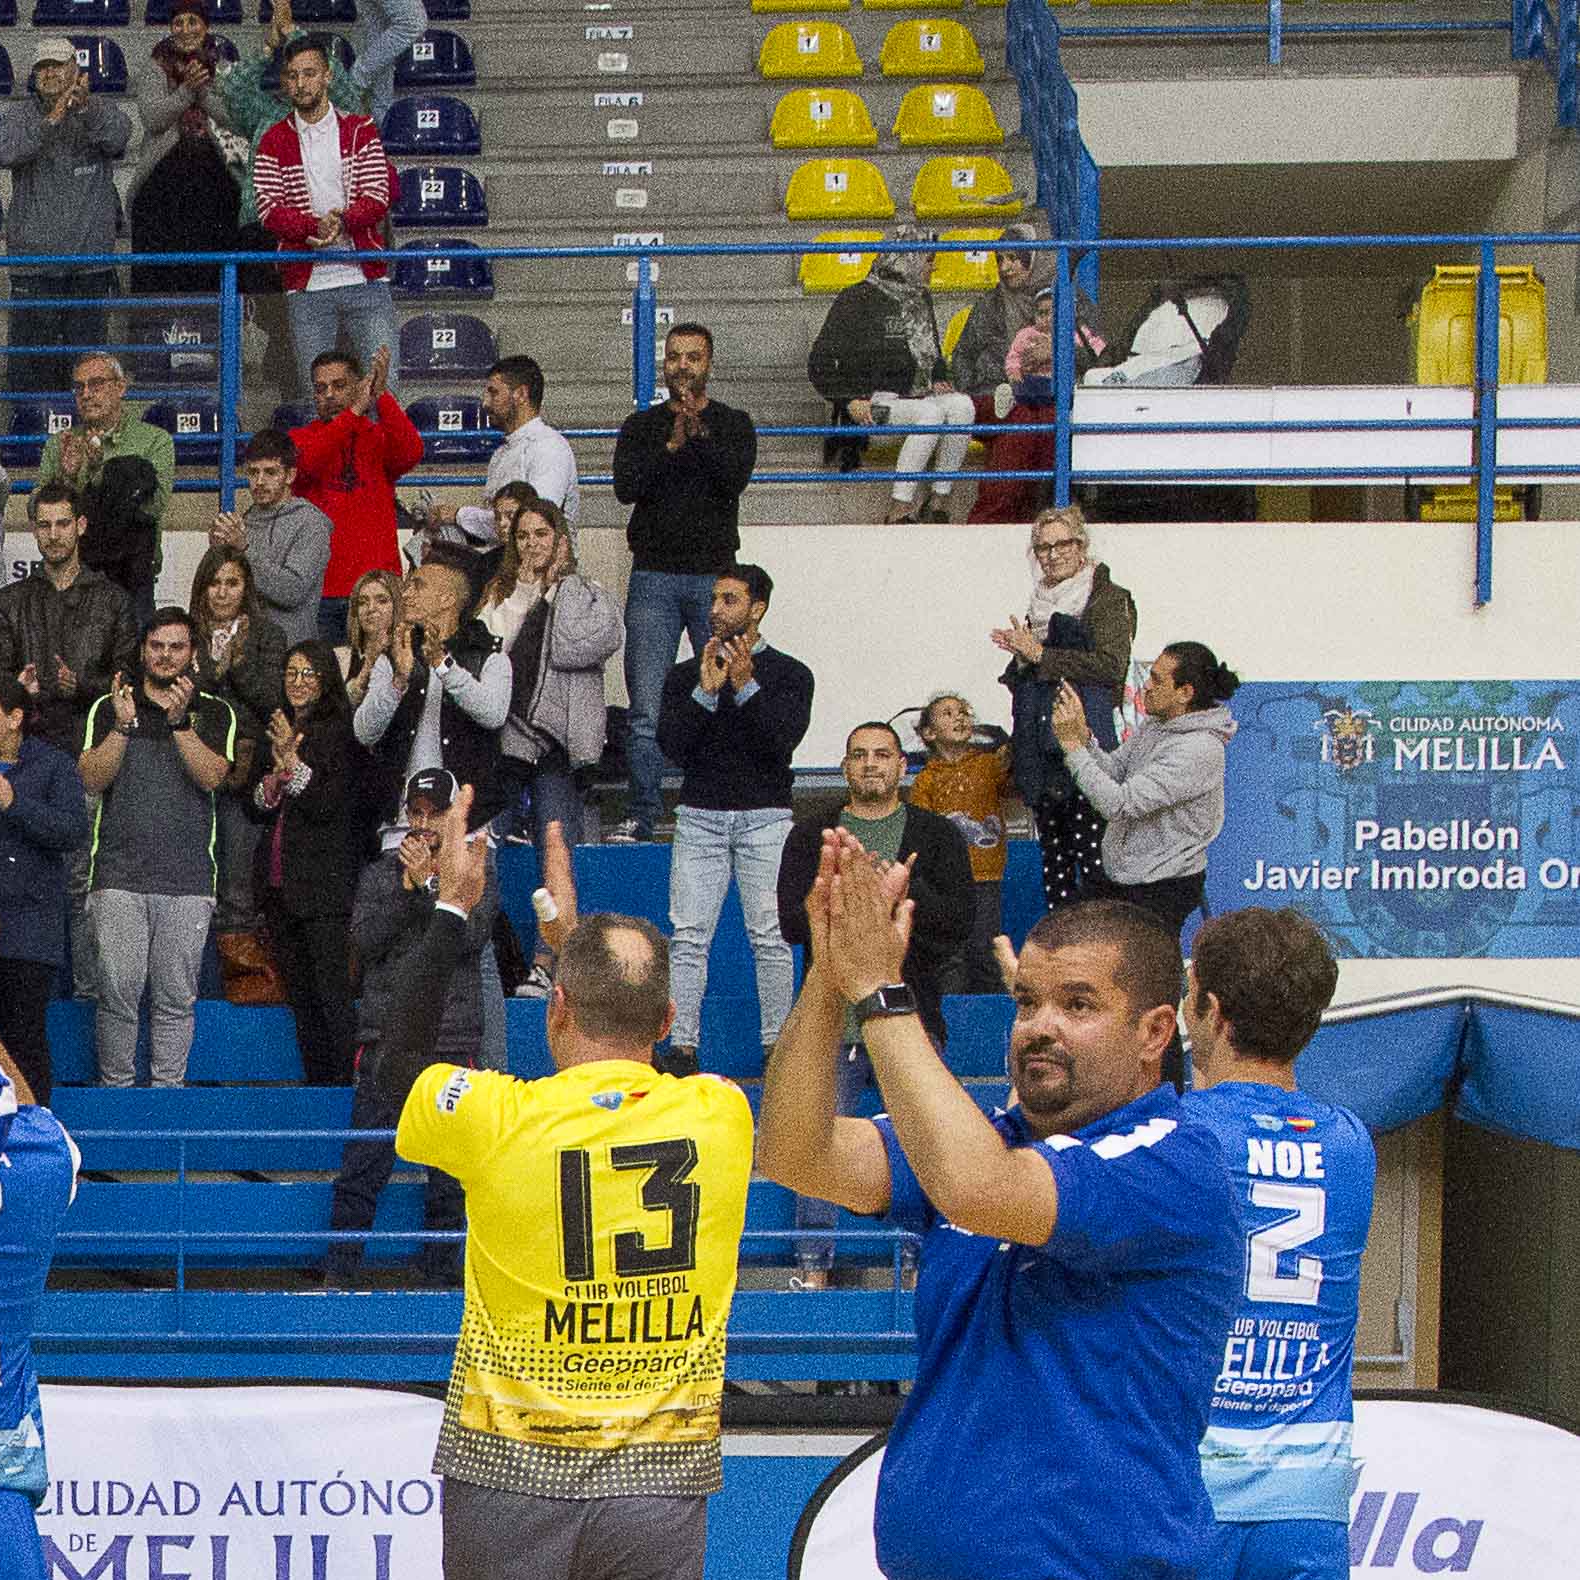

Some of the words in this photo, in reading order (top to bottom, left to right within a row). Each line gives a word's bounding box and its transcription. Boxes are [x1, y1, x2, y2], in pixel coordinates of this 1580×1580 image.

[416, 46, 432, 55] 22
[421, 114, 436, 123] 22
[426, 183, 441, 193] 22
[437, 333, 452, 343] 22
[442, 415, 459, 424] 22
[1389, 717, 1454, 733] CIUDAD
[1458, 713, 1564, 733] AUTÓNOMA
[1392, 736, 1565, 772] MELILLA
[1354, 819, 1520, 851] Pabellón
[1243, 859, 1360, 891] Javier
[1371, 859, 1526, 891] Imbroda
[1247, 1138, 1325, 1179] NOE
[555, 1136, 702, 1283] 13
[1243, 1179, 1327, 1306] 2
[544, 1294, 707, 1346] MELILLA
[219, 1470, 444, 1517] AUTÓNO
[69, 1532, 97, 1553] DE
